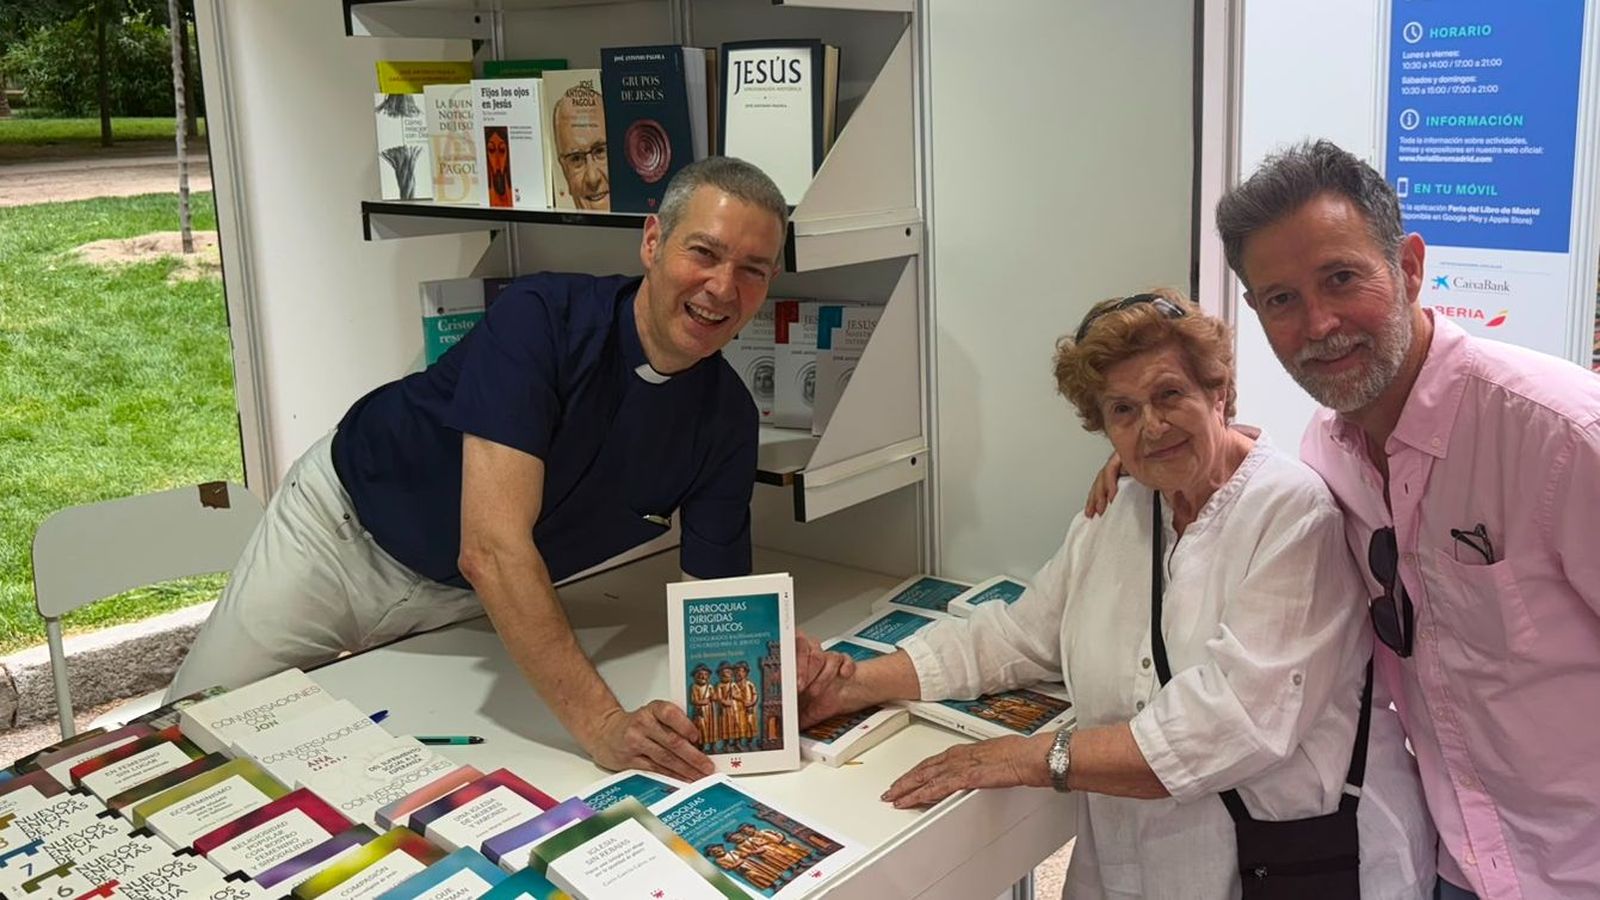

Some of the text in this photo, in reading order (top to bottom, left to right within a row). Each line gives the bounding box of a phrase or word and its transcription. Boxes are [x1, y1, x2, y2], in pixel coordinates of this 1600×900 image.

[1430, 24, 1492, 39] HORARIO
[1402, 51, 1424, 60] Lunes
[1481, 58, 1502, 67] 21:00
[622, 75, 661, 88] GRUPOS
[734, 56, 802, 95] JESÚS
[1402, 75, 1433, 85] Sábados
[578, 80, 595, 90] JOSÉ
[1478, 84, 1499, 93] 21:00
[481, 87, 531, 100] Fijos los ojos
[565, 89, 595, 99] ANTONIO
[621, 87, 665, 101] DE JESÚS
[435, 98, 473, 109] LA BUEN
[481, 99, 512, 112] en Jesús
[571, 99, 597, 108] PAGOLA
[1426, 113, 1524, 127] INFORMACIÓN
[1399, 136, 1415, 144] Toda
[1424, 136, 1463, 144] información
[1464, 136, 1485, 144] sobre
[1425, 146, 1465, 155] expositores
[1475, 146, 1503, 154] nuestra
[1503, 146, 1518, 154] web
[439, 162, 478, 176] PAGOL
[1413, 182, 1499, 196] EN TU MÓVIL
[1413, 205, 1447, 213] aplicación
[1464, 205, 1479, 213] del
[1480, 206, 1500, 214] Libro
[1511, 207, 1540, 215] Madrid
[1442, 214, 1467, 223] Google
[1468, 215, 1484, 224] Play
[1489, 216, 1510, 225] Apple
[1511, 216, 1533, 226] Store)
[1452, 277, 1511, 292] CaixaBank
[1436, 305, 1486, 320] BERIA
[437, 318, 475, 332] Cristo
[688, 601, 747, 614] PARROQUIAS
[689, 613, 734, 625] DIRIGIDAS
[689, 622, 744, 636] POR LAICOS
[211, 685, 321, 730] CONVERSACIONES
[245, 711, 276, 727] CON
[255, 719, 280, 733] JON
[262, 718, 372, 765] CONVERSACIONES
[298, 747, 328, 761] CON
[307, 755, 334, 769] ANA
[341, 761, 453, 811] CONVERSACIONES
[169, 785, 232, 817] ECOFEMINISMO
[588, 785, 622, 807] OQUIAS
[15, 798, 78, 827] NUEVOS
[453, 797, 497, 822] UNA IGLESIA
[661, 796, 706, 825] RROQUIAS
[20, 802, 89, 836] ENIGMAS
[667, 807, 702, 831] RIGIDAS
[673, 807, 718, 837] OR LAICOS
[26, 826, 45, 839] DE
[48, 818, 70, 831] LA
[231, 820, 289, 851] RELIGIOSIDAD
[42, 821, 106, 854] NUEVOS
[48, 825, 119, 861] ENIGMAS
[247, 830, 284, 851] POPULAR
[77, 844, 99, 857] LA
[244, 831, 298, 860] CON ROSTRO
[254, 837, 299, 862] FEMENINO
[587, 838, 618, 857] IGLESIA
[75, 840, 139, 874] NUEVOS
[81, 843, 153, 882] ENIGMAS
[585, 856, 600, 866] SIN
[19, 862, 34, 877] 7
[90, 875, 111, 888] DE
[112, 863, 136, 877] LA
[118, 859, 184, 895] NUEVOS
[126, 861, 199, 900] ENIGMAS
[340, 865, 390, 897] COMPASIÓN
[57, 884, 75, 898] 6
